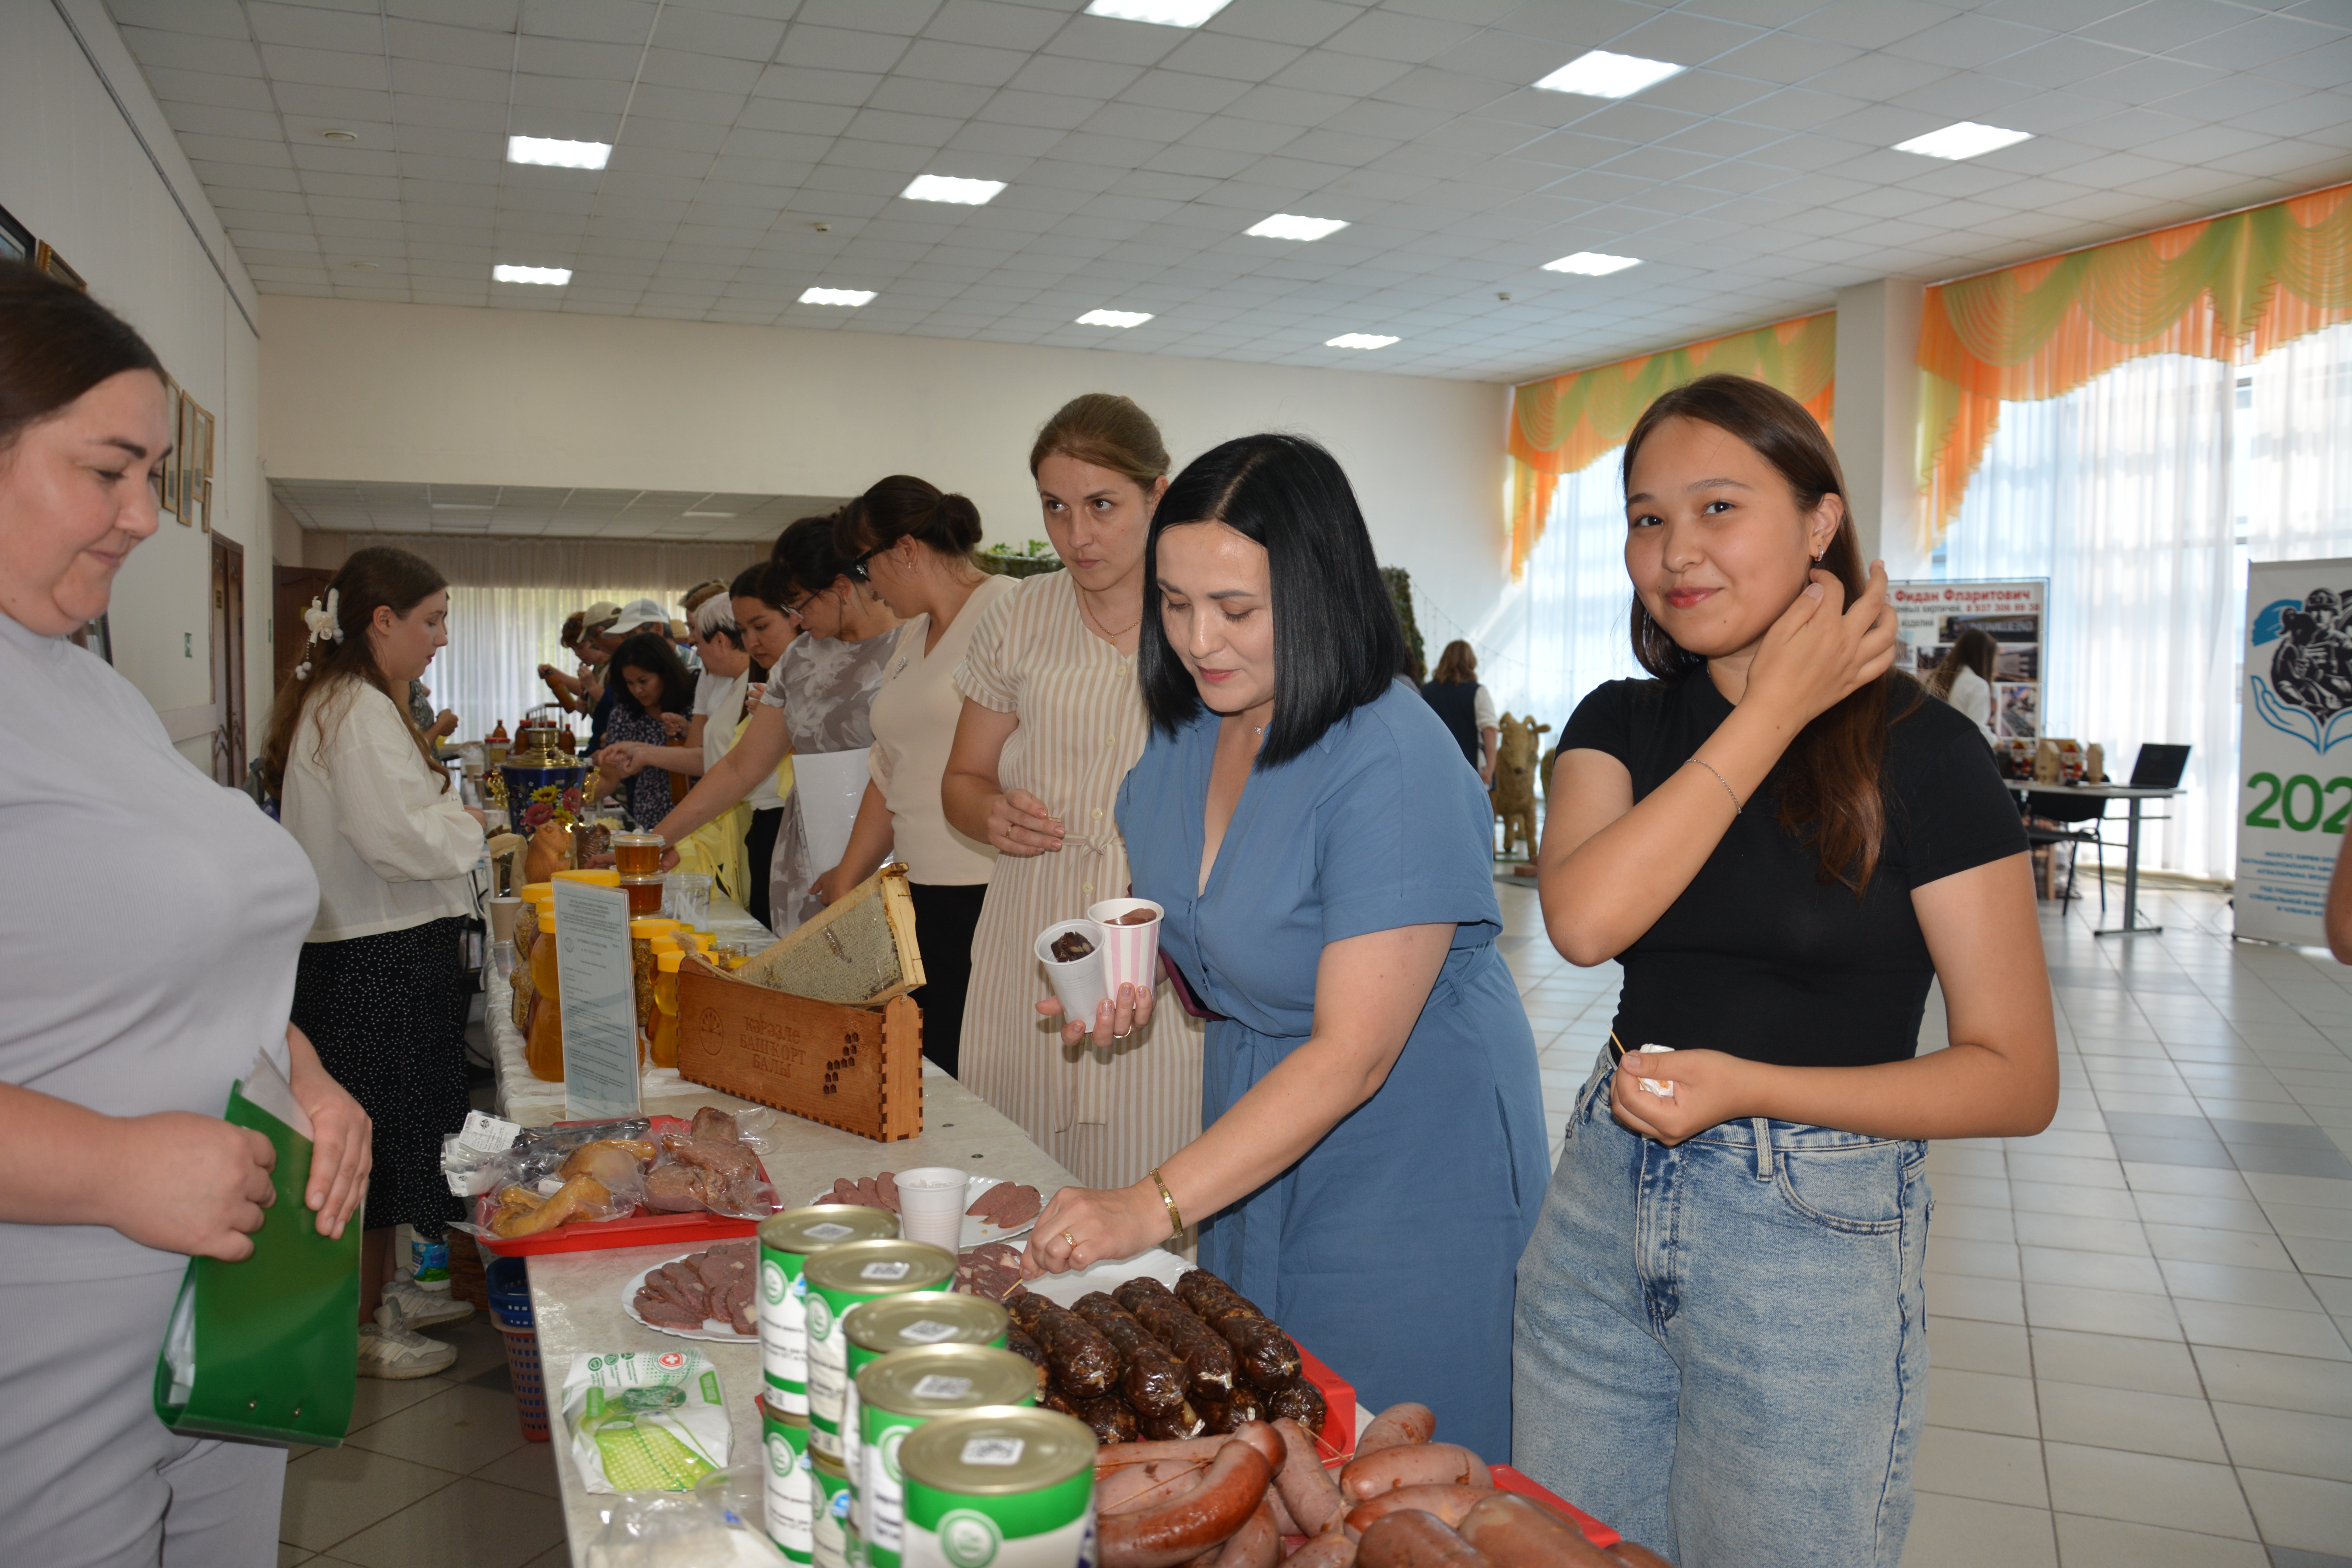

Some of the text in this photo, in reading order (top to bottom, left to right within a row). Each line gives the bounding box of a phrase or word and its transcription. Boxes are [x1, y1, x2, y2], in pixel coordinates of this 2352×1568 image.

[1895, 590, 1939, 603] Фидан
[1944, 589, 2030, 603] Фларитович
[753, 1053, 792, 1078] БАЛЫ
